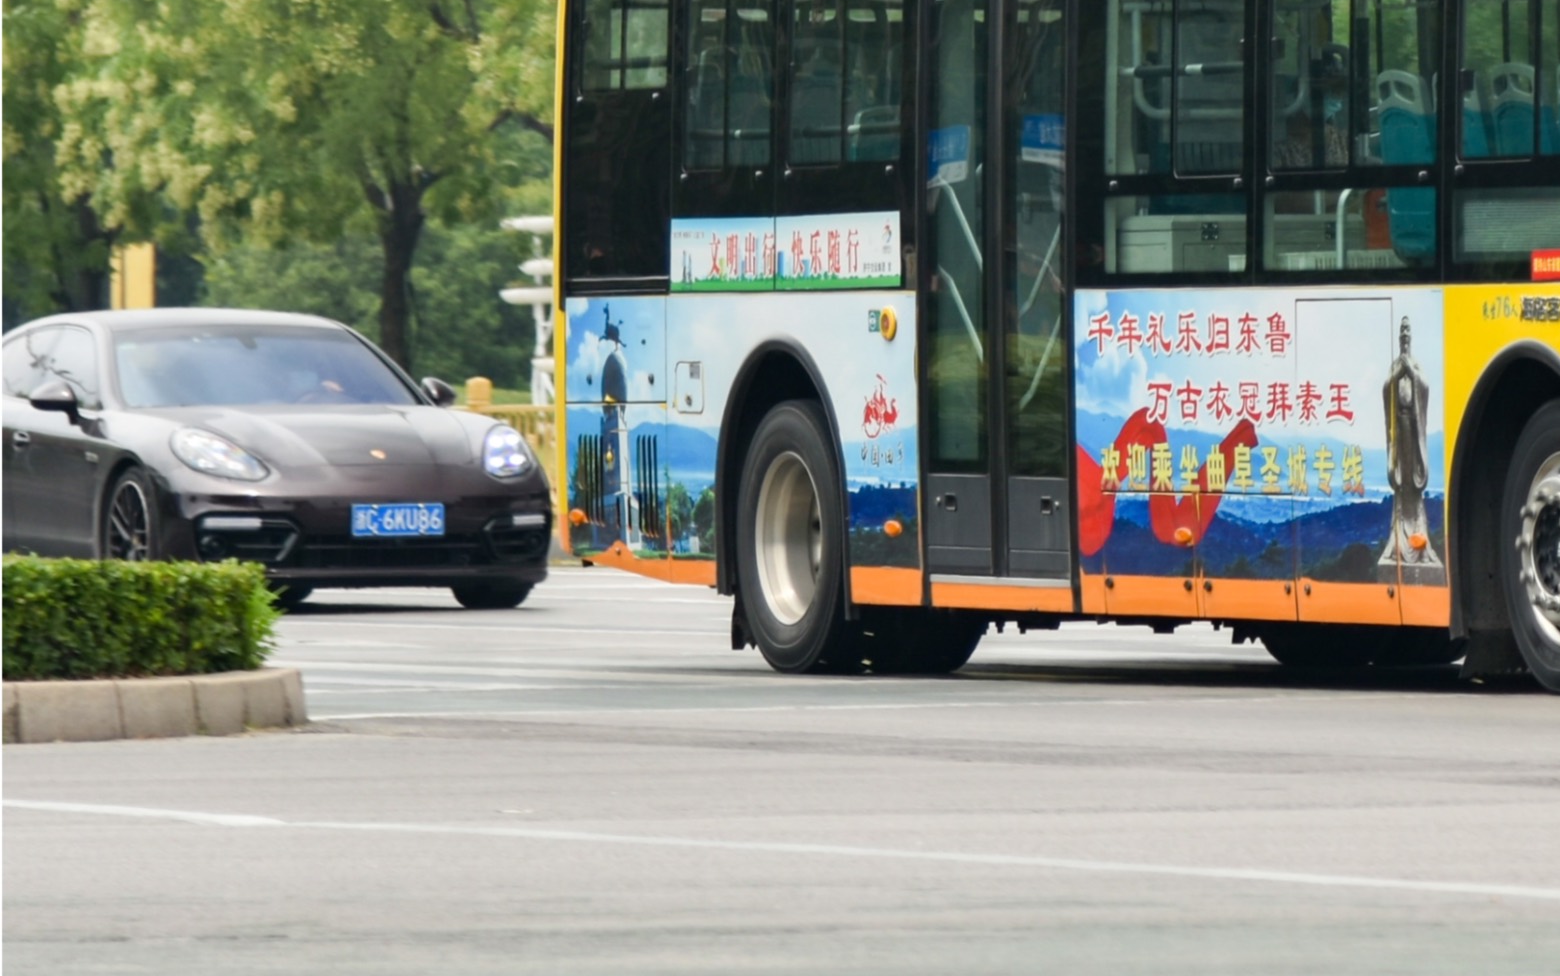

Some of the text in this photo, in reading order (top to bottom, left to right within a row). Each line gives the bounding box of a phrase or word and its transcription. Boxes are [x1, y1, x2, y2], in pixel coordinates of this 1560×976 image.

[709, 229, 859, 276] 文明出行 快乐随行
[1087, 311, 1292, 355] 千年礼乐归东鲁
[1146, 380, 1355, 423] 万古衣冠拜素王
[1101, 441, 1366, 498] 欢迎乘坐曲阜圣城专线
